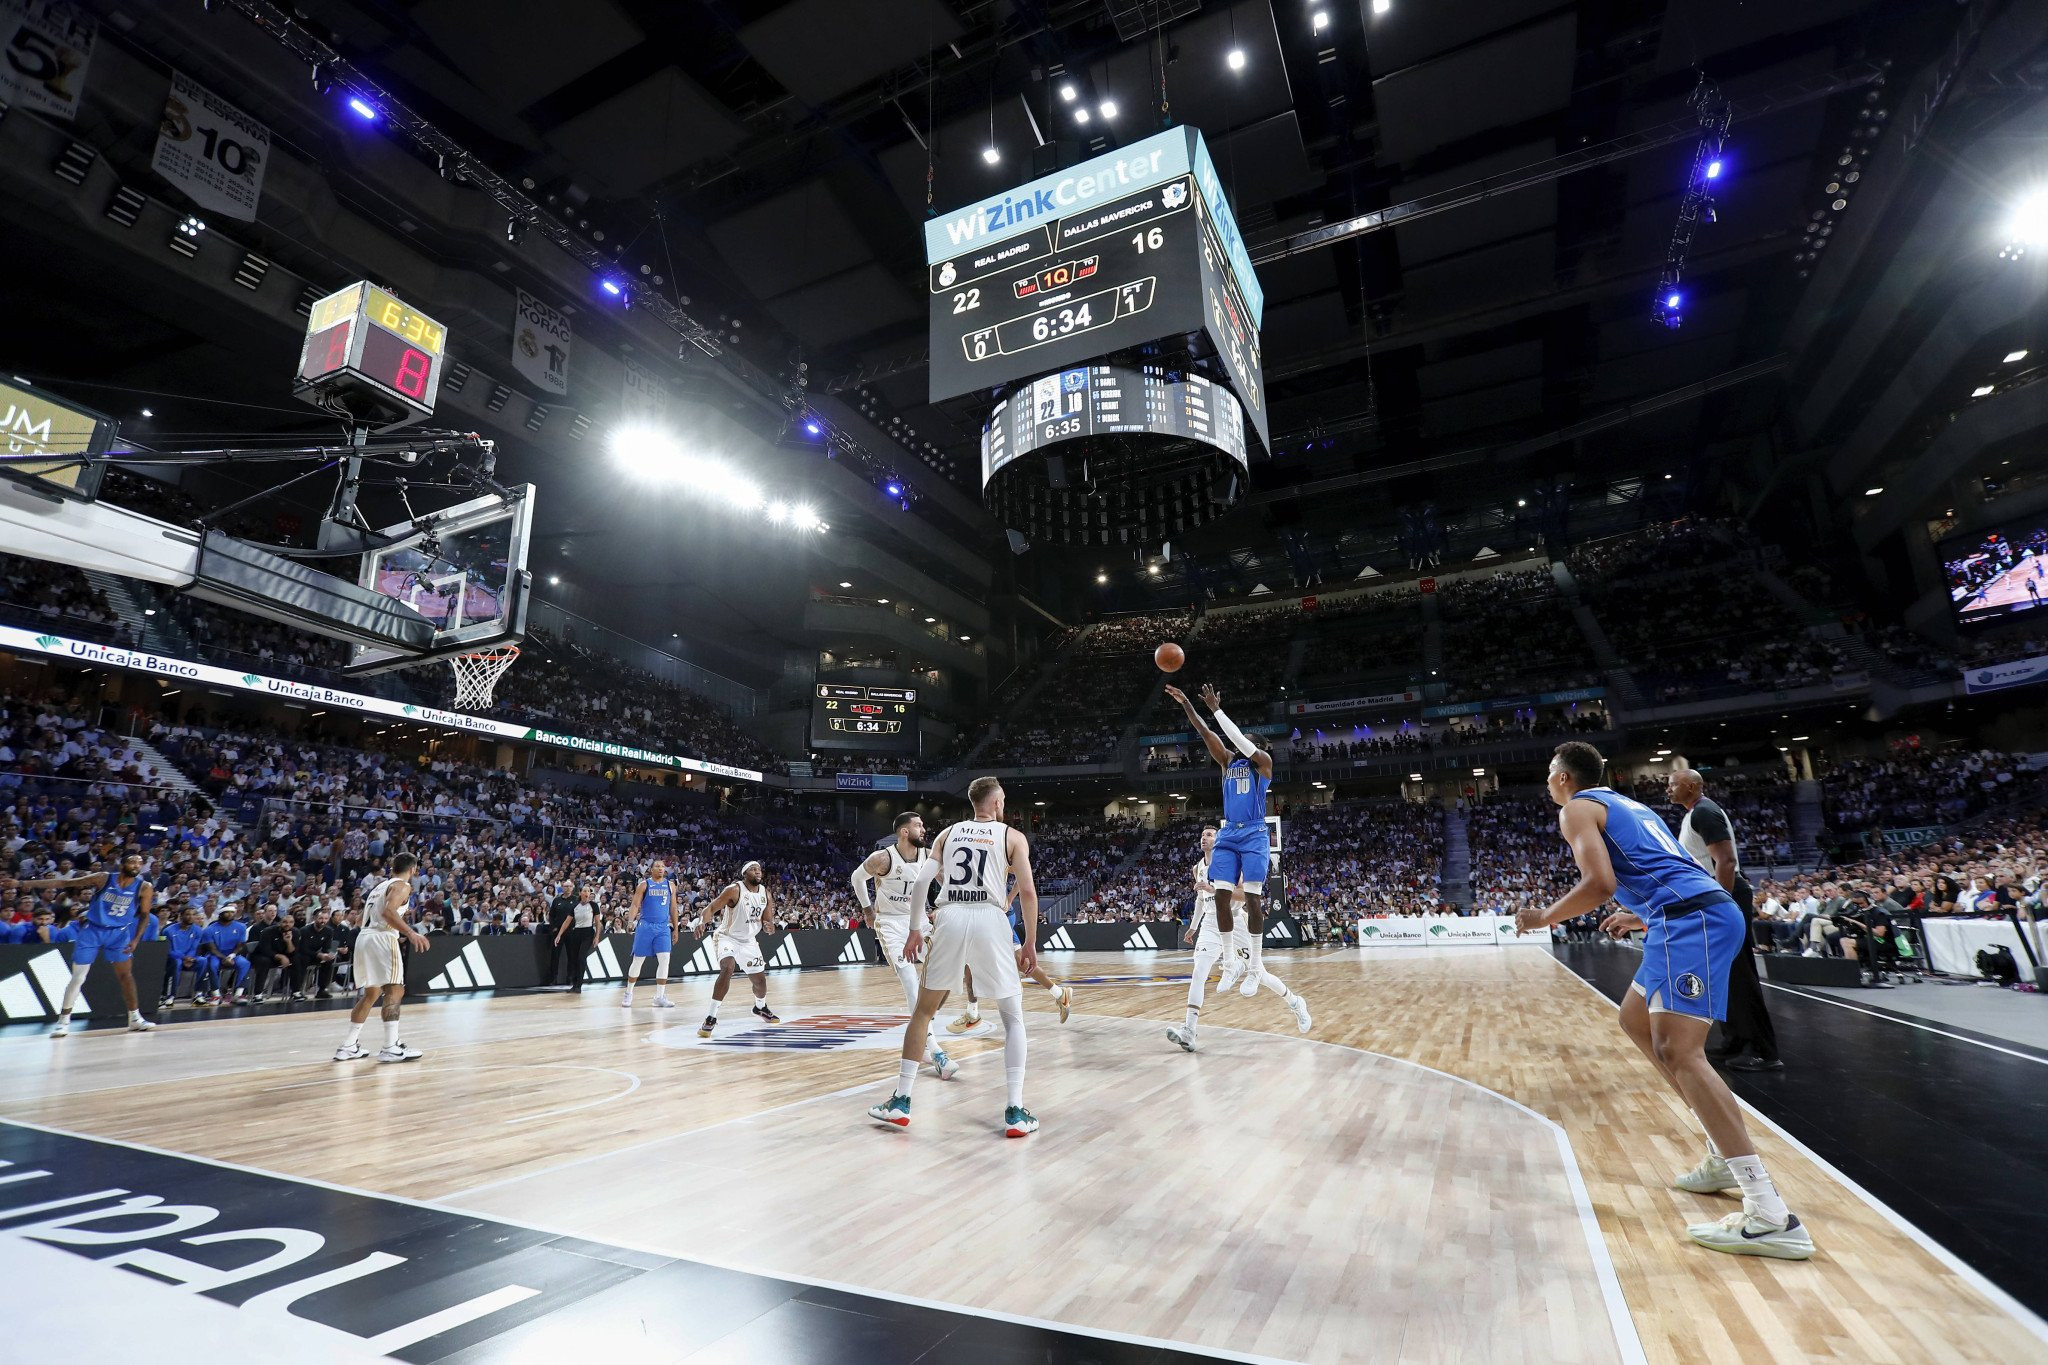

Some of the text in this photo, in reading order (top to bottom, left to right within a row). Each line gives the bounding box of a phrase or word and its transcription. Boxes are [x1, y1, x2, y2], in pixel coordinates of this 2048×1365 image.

[6, 26, 57, 80] 5
[174, 82, 200, 102] DE
[196, 126, 246, 175] 10
[1063, 200, 1154, 237] DALLAS MAVERICKS
[1132, 227, 1164, 255] 16
[974, 242, 1031, 269] REAL MADRID
[1043, 267, 1069, 288] 1Q
[1122, 282, 1144, 296] FT
[953, 288, 981, 315] 22
[1124, 294, 1135, 313] 1
[519, 291, 571, 332] COPA
[382, 301, 442, 354] 6:34
[519, 304, 570, 343] KORAC
[1032, 302, 1092, 341] 6:34
[973, 330, 992, 343] FT
[974, 341, 987, 359] 0
[395, 348, 430, 397] 8
[544, 371, 565, 389] 1988
[1041, 399, 1056, 421] 22
[1045, 418, 1082, 439] 6:35
[70, 641, 199, 678] Unicaja Banco
[268, 678, 364, 708] Unicaja Banco
[1554, 690, 1591, 702] WiZink
[826, 701, 838, 709] 22
[894, 704, 905, 713] 16
[1314, 700, 1355, 710] Comunidad
[1367, 696, 1394, 704] Madrid
[1436, 704, 1470, 716] WiZink
[421, 709, 497, 733] Unicaja Banco
[856, 722, 880, 731] 6:34
[535, 729, 674, 766] Banco Oficial del Real Madrid
[1150, 735, 1178, 744] WiZink
[710, 763, 752, 780] Unicaja Banco
[838, 778, 871, 787] WiZink
[1235, 778, 1250, 795] 10
[960, 827, 993, 836] MUSA
[952, 836, 995, 846] AUTOHERO
[949, 846, 988, 887] 31
[661, 895, 668, 906] 3
[948, 889, 988, 902] MADRID
[107, 903, 130, 917] 55
[750, 906, 762, 918] 28
[1379, 932, 1402, 940] Unicaja
[1447, 931, 1471, 939] Unicaja
